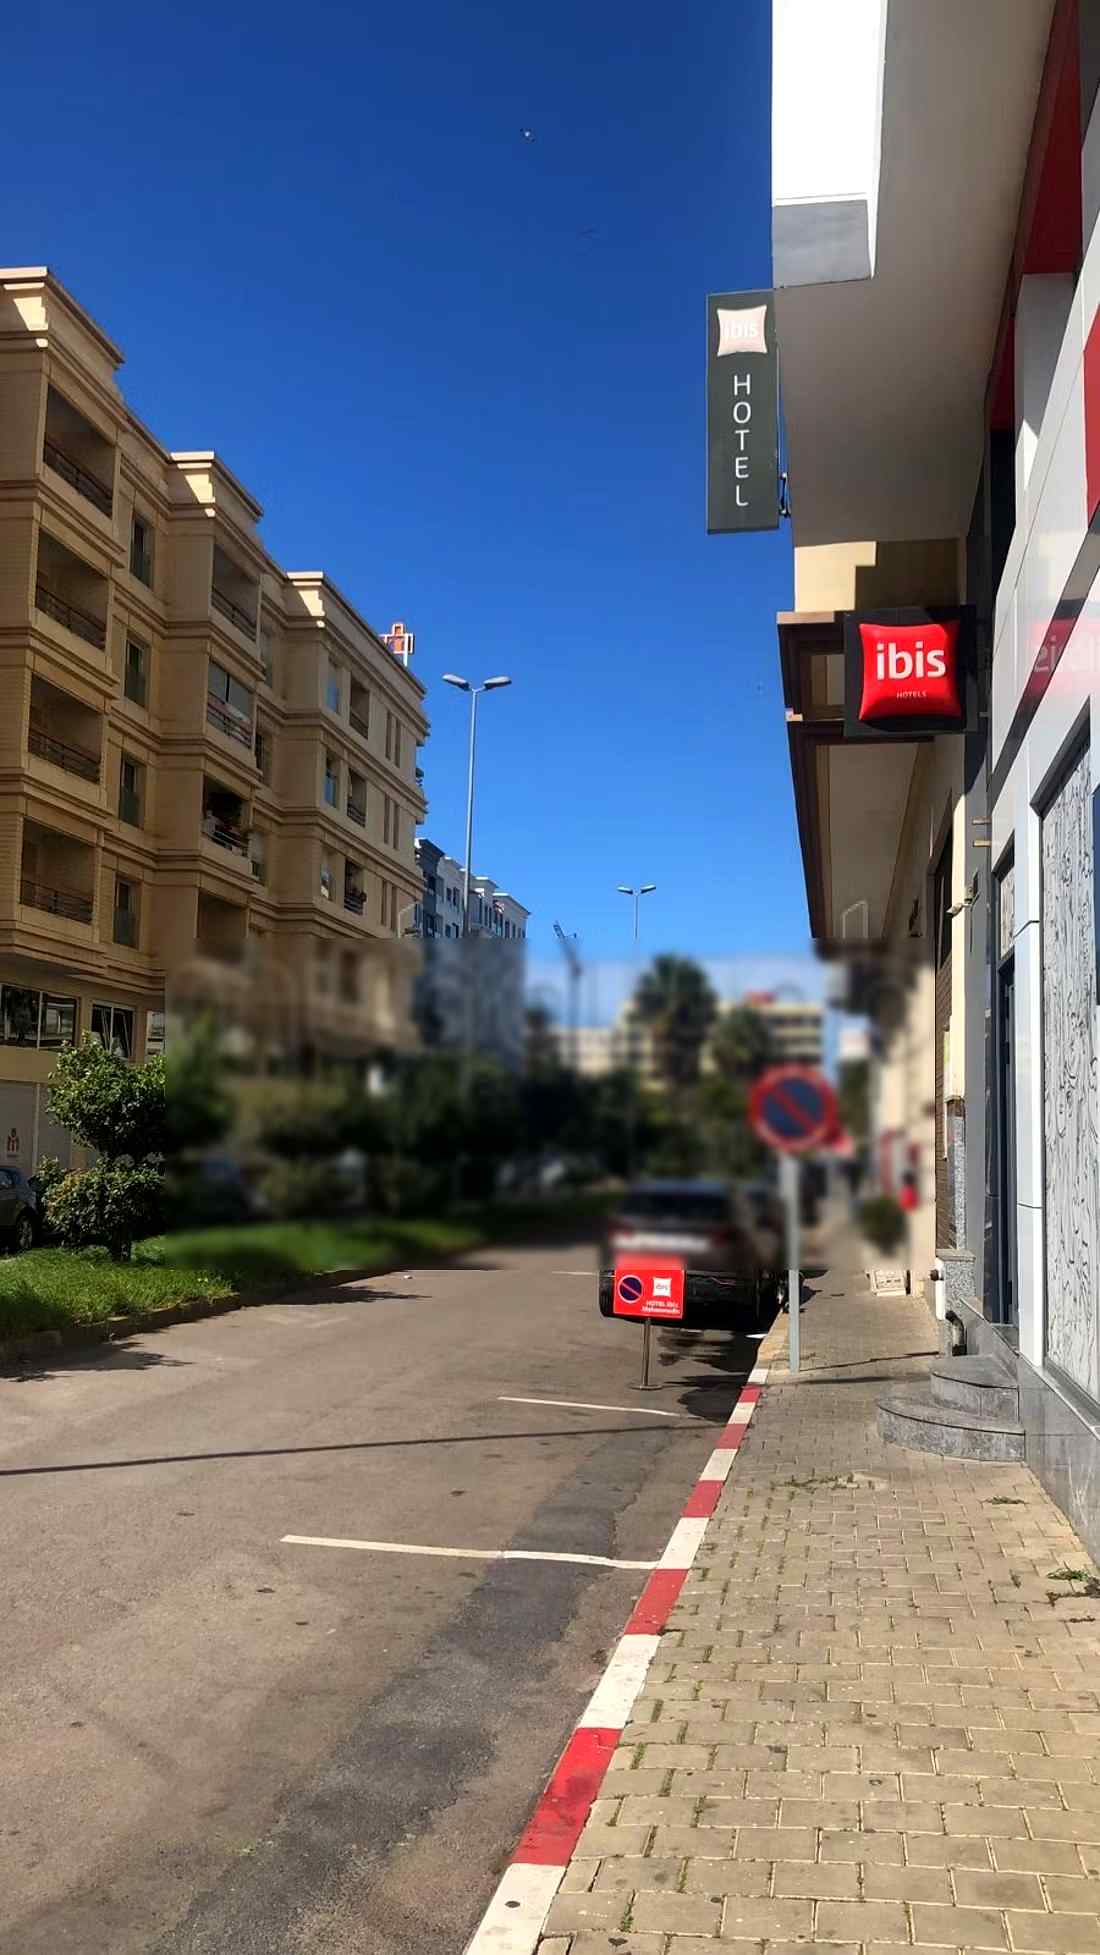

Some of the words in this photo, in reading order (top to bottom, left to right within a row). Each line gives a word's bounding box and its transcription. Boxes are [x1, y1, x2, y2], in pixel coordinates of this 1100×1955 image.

[721, 319, 759, 337] ibis
[732, 373, 752, 506] HOTEL
[876, 640, 946, 680] ibis
[896, 690, 927, 698] HOTELS
